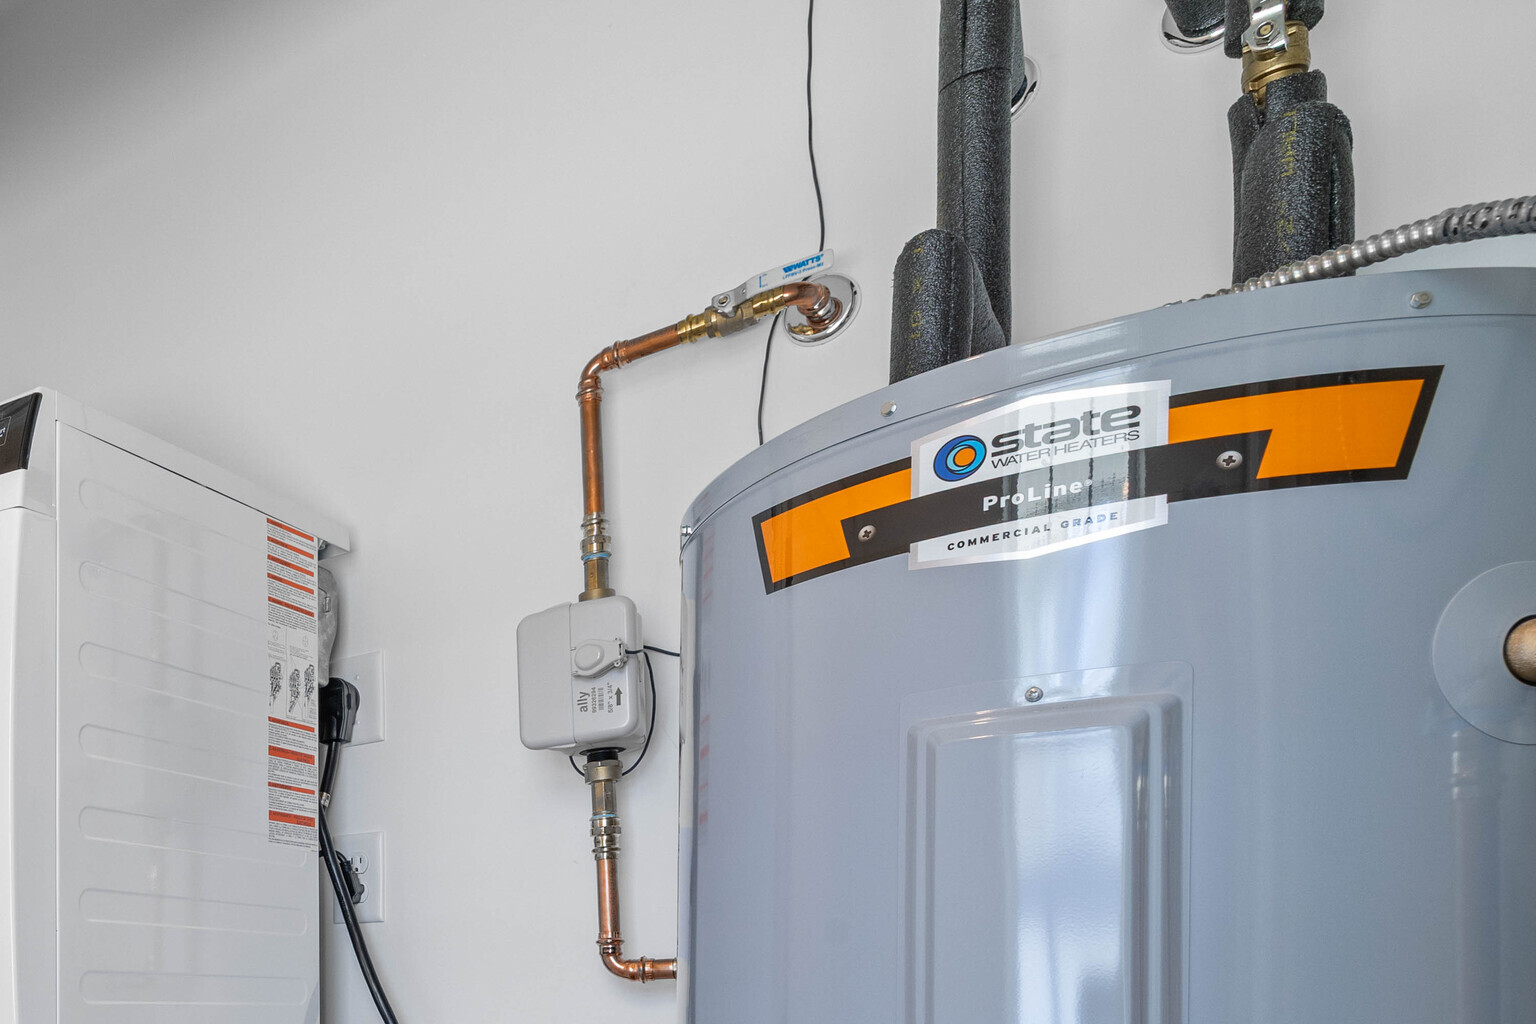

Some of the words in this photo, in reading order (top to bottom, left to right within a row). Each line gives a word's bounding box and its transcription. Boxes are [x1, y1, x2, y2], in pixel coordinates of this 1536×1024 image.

[991, 404, 1141, 458] state
[991, 446, 1051, 470] WATER
[1054, 430, 1140, 456] HEATERS
[947, 523, 1052, 551] COMMERCIAL
[1061, 511, 1119, 529] GRADE
[577, 691, 590, 712] ally
